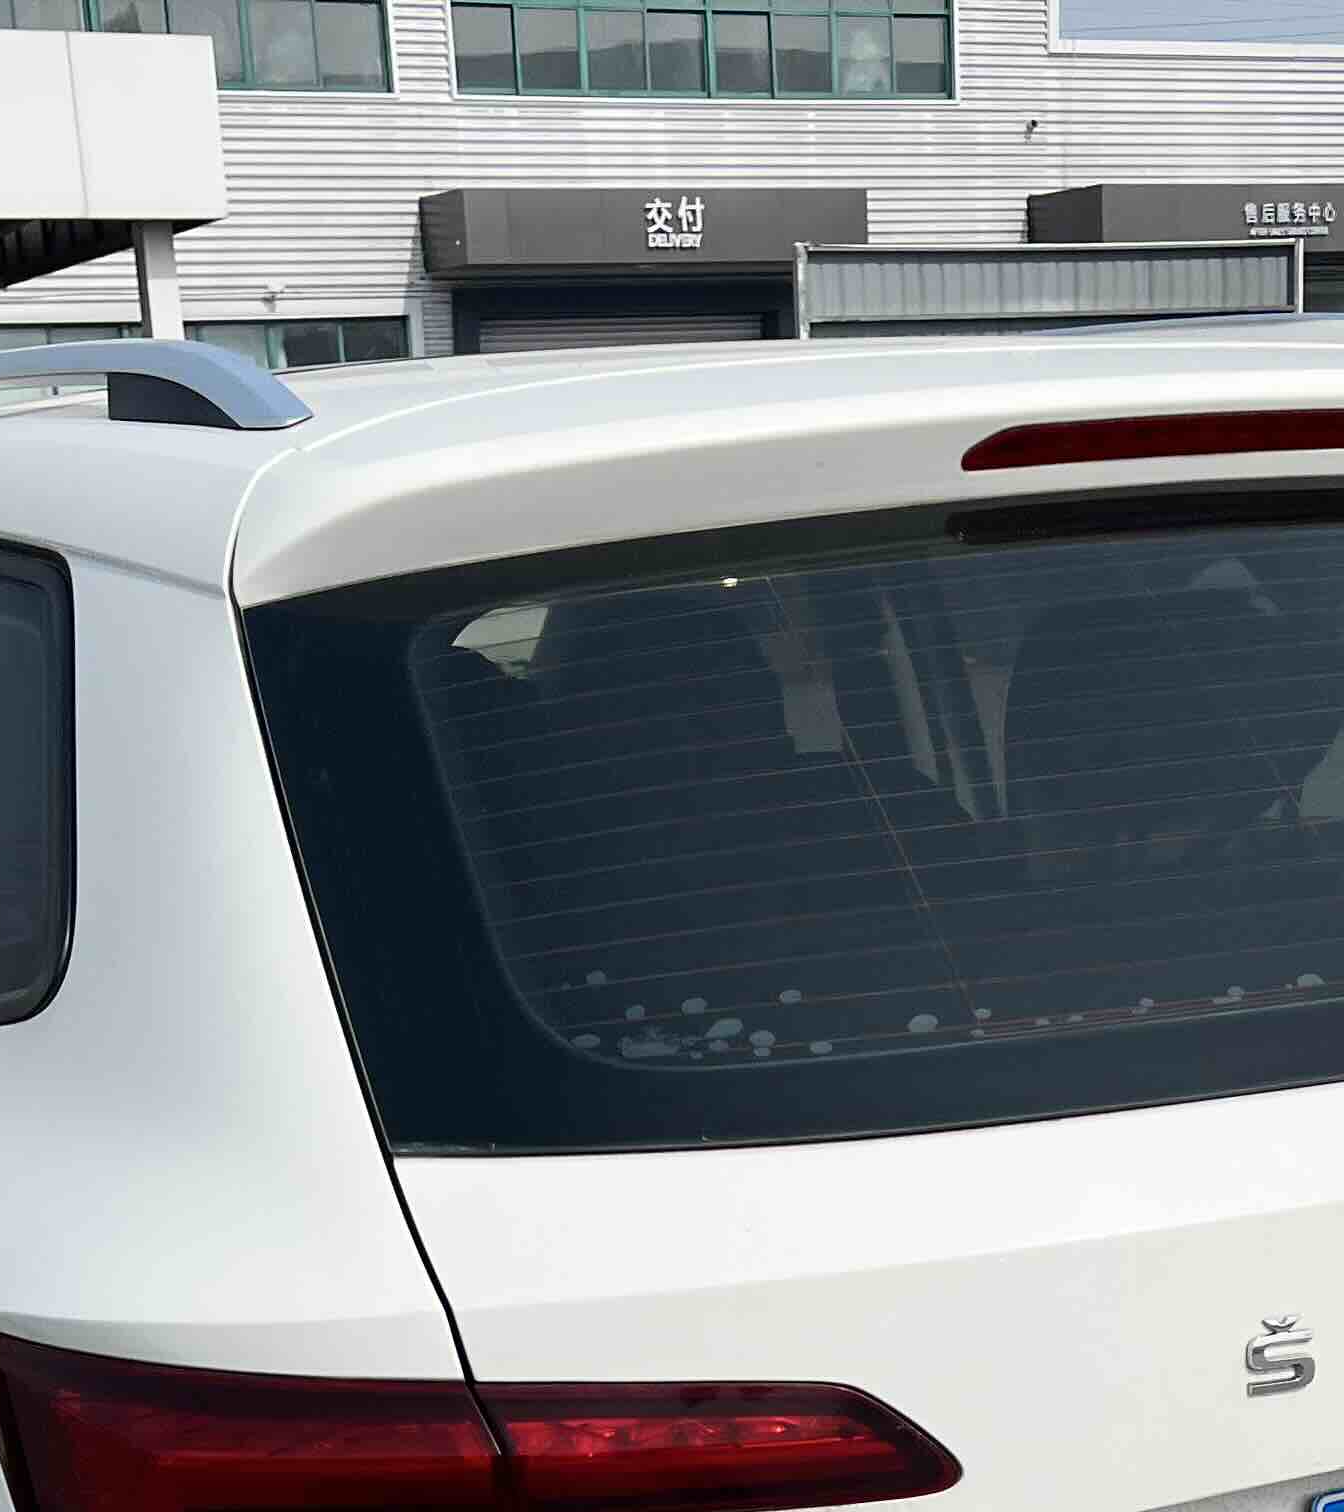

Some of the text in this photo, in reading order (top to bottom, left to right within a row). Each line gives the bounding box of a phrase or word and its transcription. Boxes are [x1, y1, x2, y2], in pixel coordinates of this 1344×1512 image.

[645, 195, 705, 233] 交付
[1244, 201, 1337, 224] 售后服务中心
